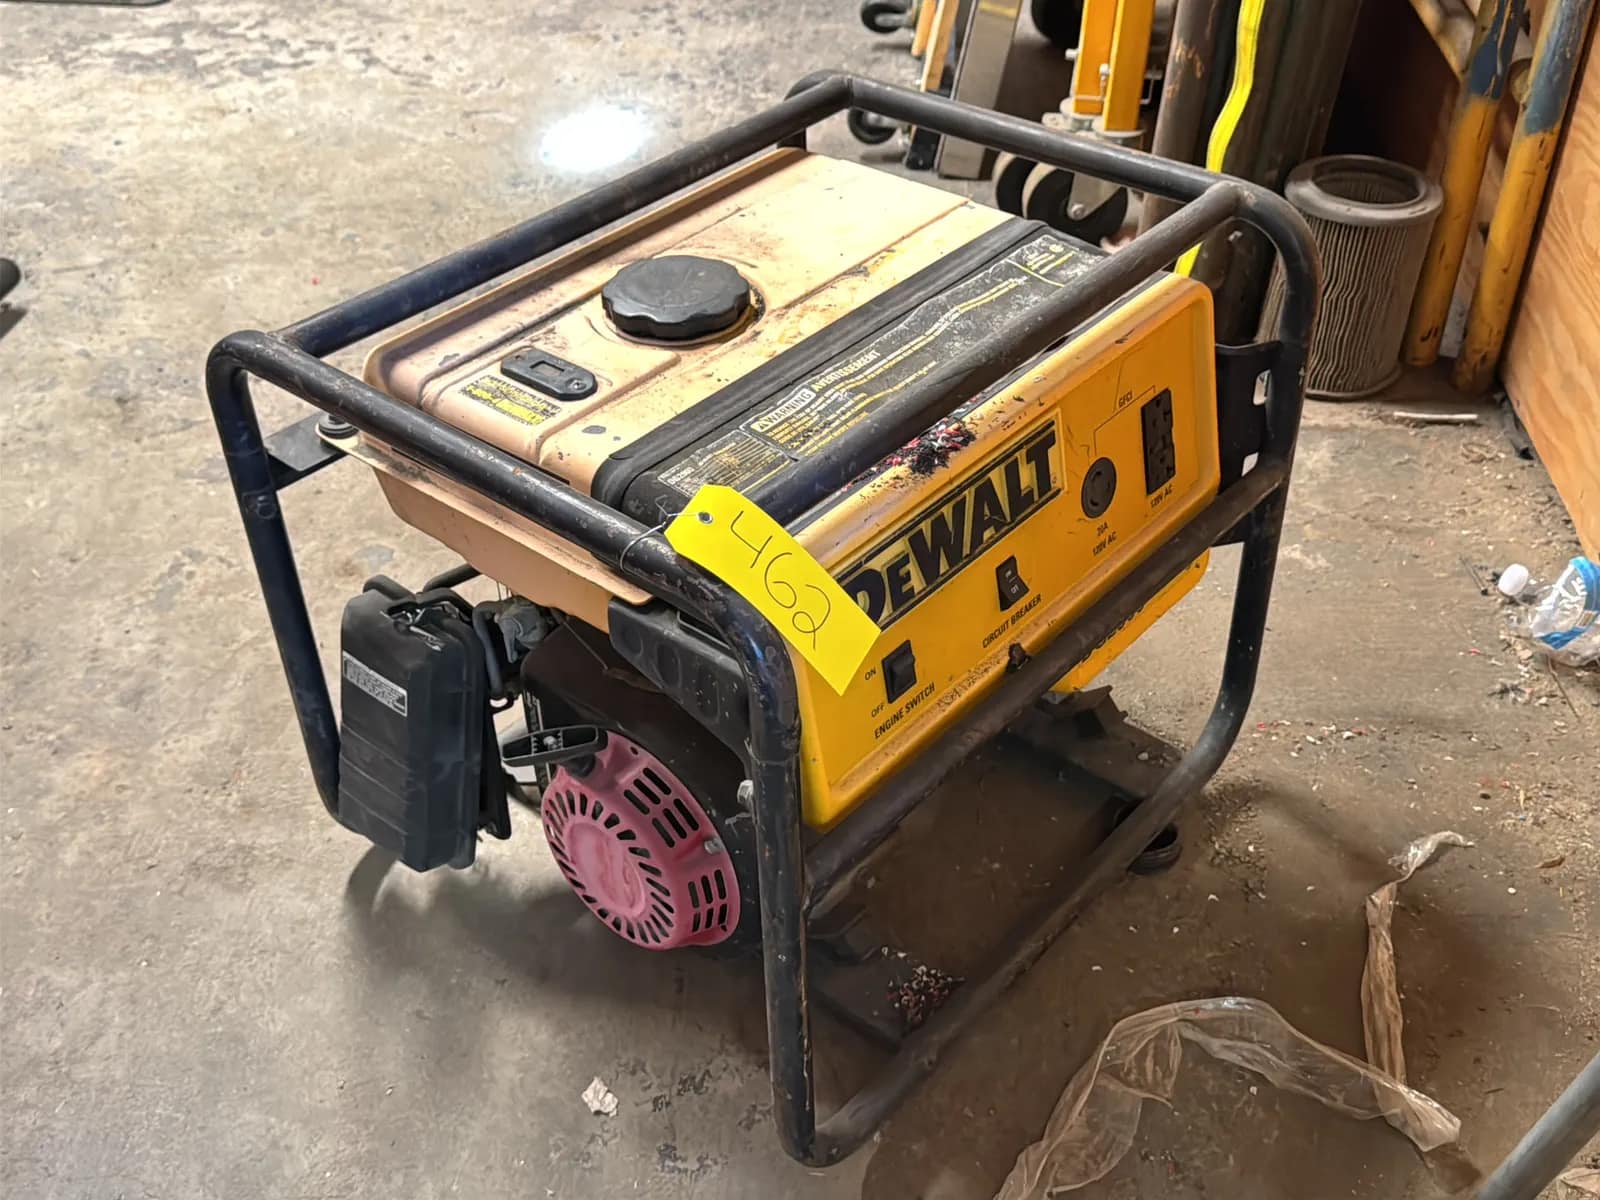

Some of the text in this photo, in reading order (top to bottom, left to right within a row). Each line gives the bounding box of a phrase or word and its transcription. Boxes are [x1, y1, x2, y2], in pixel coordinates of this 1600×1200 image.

[763, 390, 813, 427] WARNING
[810, 350, 881, 393] AVERTISSEMENT
[1118, 389, 1133, 408] GFCI
[1164, 483, 1173, 498] AC
[844, 429, 1057, 625] DEWALT
[1107, 531, 1117, 545] AC
[730, 510, 831, 650] 462
[982, 593, 1042, 649] CIRCUIT BREAKER
[864, 666, 877, 681] ON
[871, 703, 886, 718] OFF
[874, 681, 936, 740] ENGINE SWITCH
